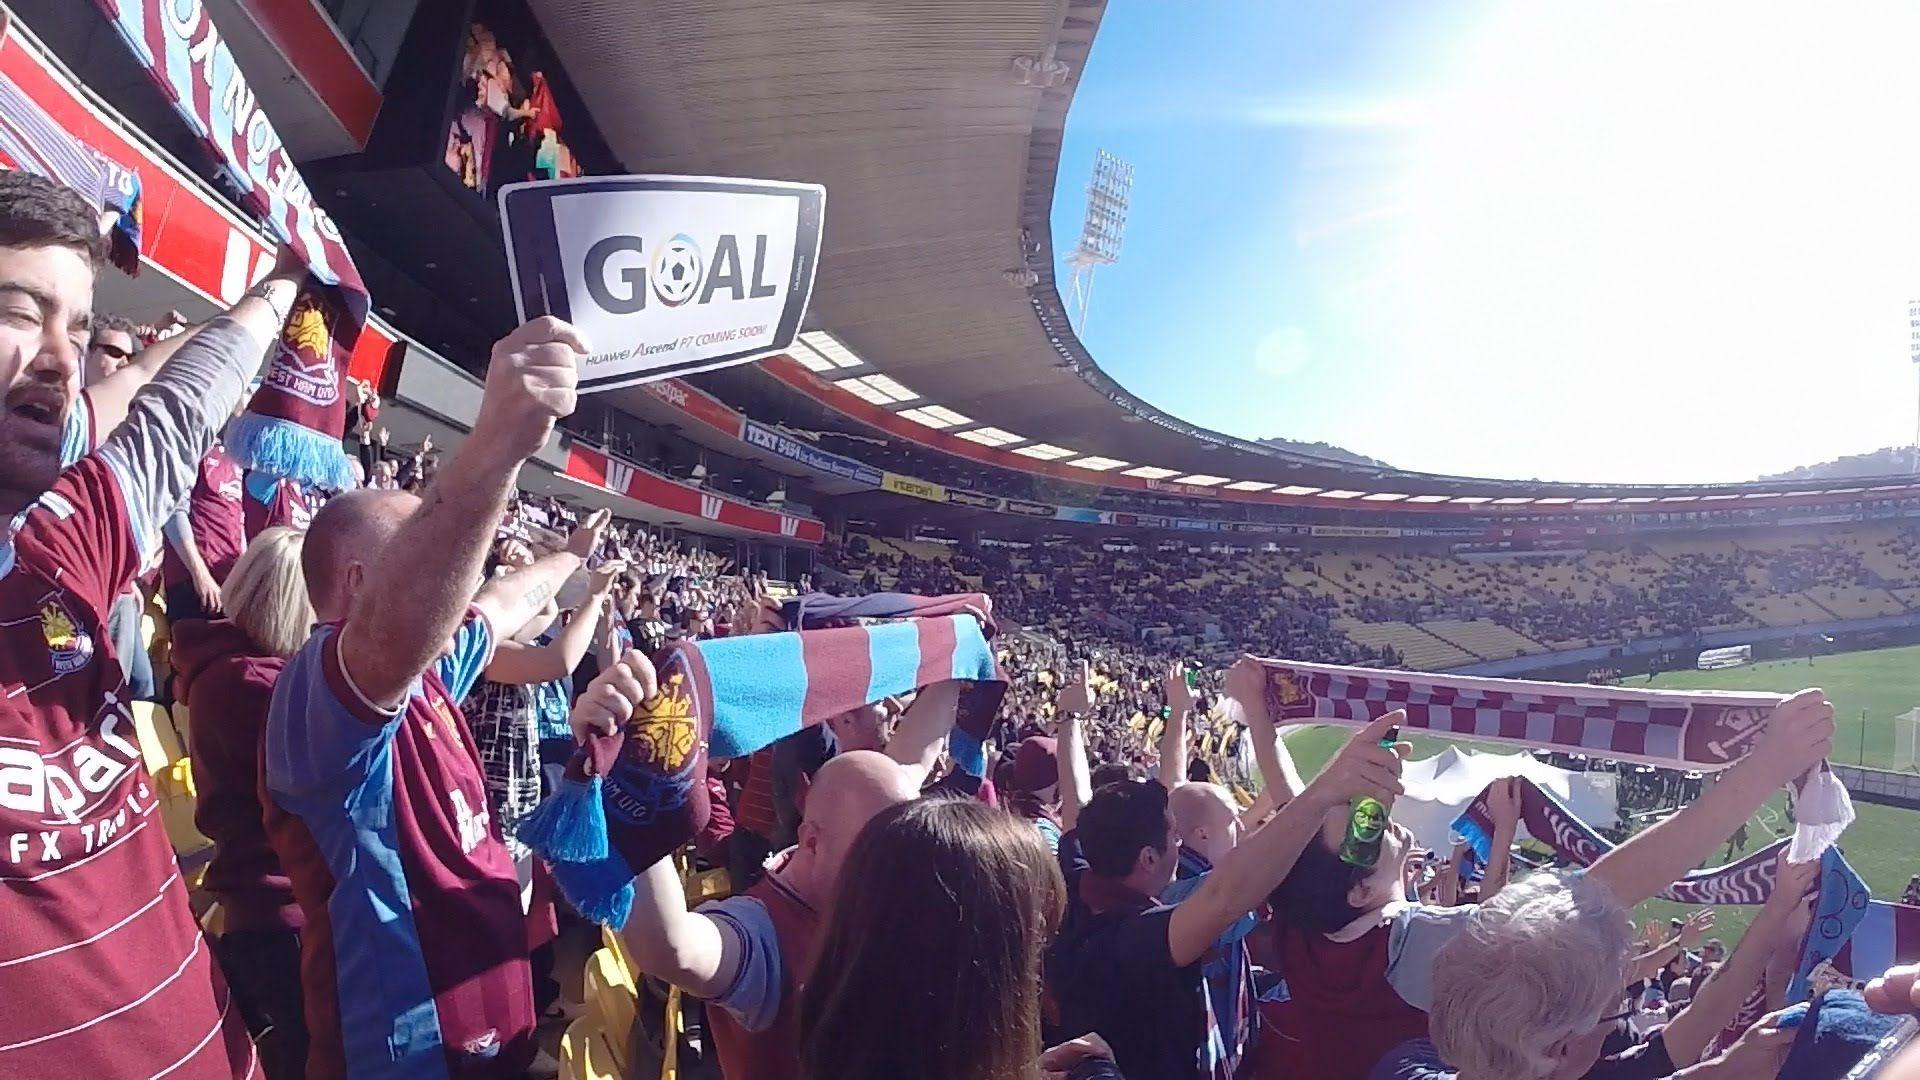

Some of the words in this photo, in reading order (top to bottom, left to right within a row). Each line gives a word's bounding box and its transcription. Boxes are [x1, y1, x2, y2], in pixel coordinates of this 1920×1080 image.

[222, 80, 275, 165] ON
[583, 233, 777, 315] GOAL
[585, 350, 630, 367] HUAWEI
[631, 338, 678, 358] Ascend
[680, 335, 694, 348] P7
[695, 328, 736, 346] COMING
[267, 366, 292, 387] EST
[293, 377, 317, 397] HAM
[747, 424, 778, 450] TEXT
